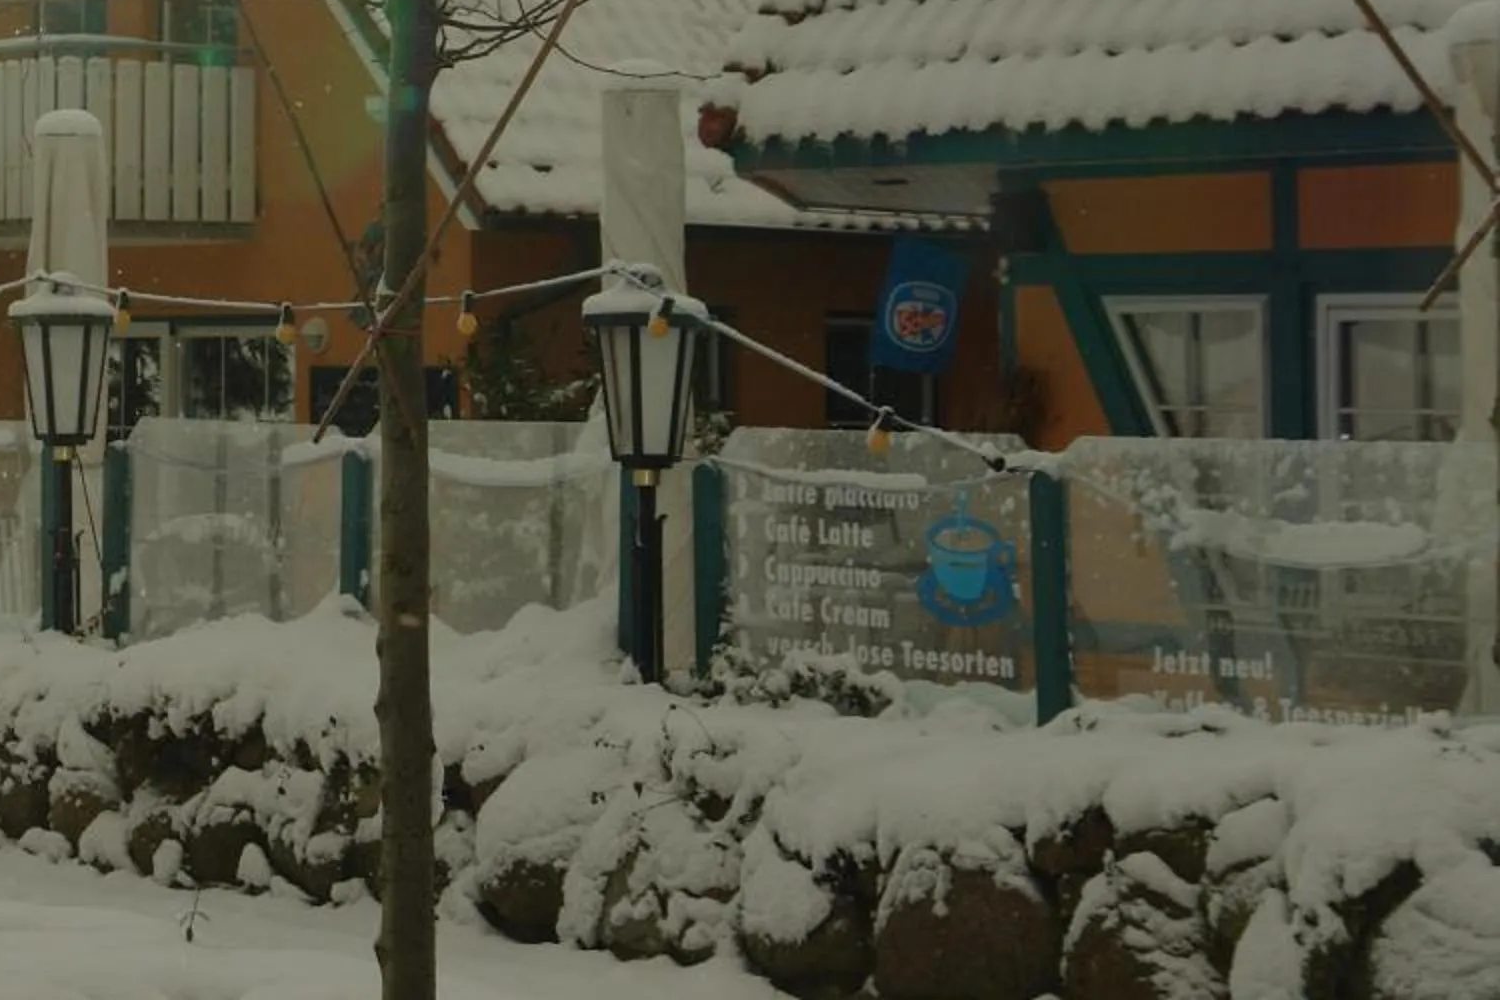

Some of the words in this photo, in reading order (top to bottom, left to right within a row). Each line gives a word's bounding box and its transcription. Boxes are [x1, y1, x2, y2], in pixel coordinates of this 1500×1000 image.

[818, 517, 875, 548] Latte
[764, 554, 882, 589] Cappuccino
[821, 596, 891, 630] Cream
[900, 640, 1015, 679] Teesorten
[1153, 646, 1211, 675] Jetzt
[1219, 652, 1274, 681] neu!
